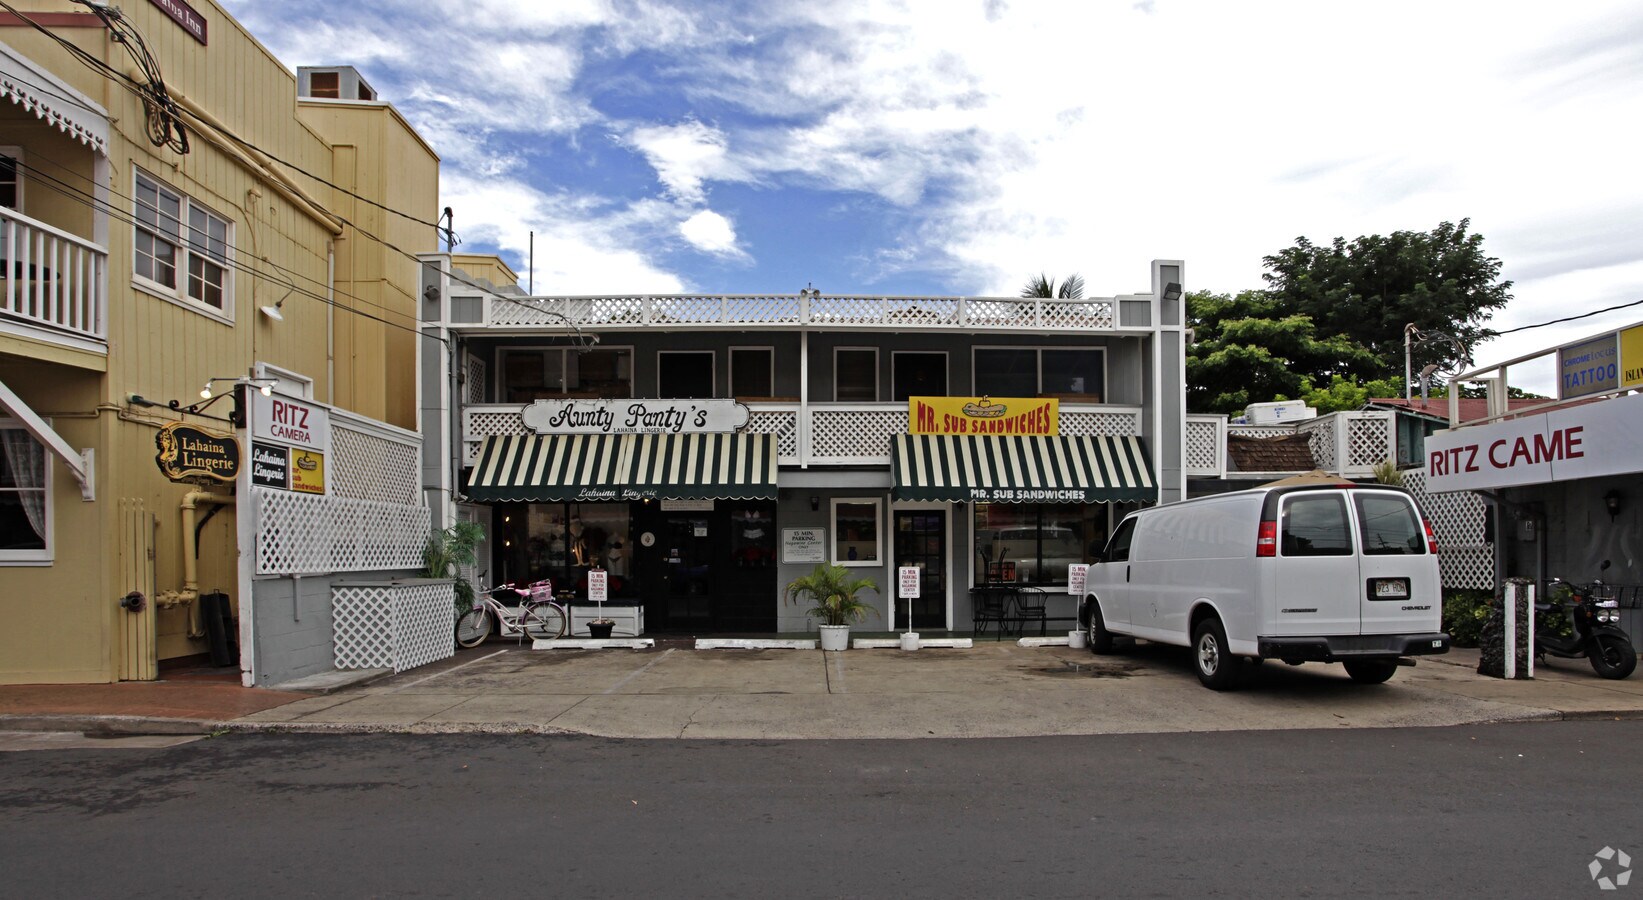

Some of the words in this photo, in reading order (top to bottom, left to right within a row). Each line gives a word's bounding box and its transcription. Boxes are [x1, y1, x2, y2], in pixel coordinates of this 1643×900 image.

[186, 10, 202, 35] Inn
[1564, 363, 1616, 388] TATTOO
[272, 400, 309, 429] RITZ
[549, 403, 615, 433] Aunty
[624, 403, 708, 433] Panty's
[917, 400, 939, 433] MR.
[943, 413, 967, 433] SUB
[971, 402, 1051, 434] SANDWICHES
[271, 424, 311, 443] CAMERA
[182, 437, 225, 454] Lahaina
[1430, 444, 1479, 477] RITZ
[1488, 425, 1584, 469] CAME
[183, 452, 234, 473] Lingerie
[252, 448, 286, 466] Lahaina
[253, 462, 285, 482] Lingerie
[578, 488, 616, 498] Lahaina
[970, 489, 990, 499] MR.
[993, 490, 1014, 499] SUB
[1016, 490, 1086, 500] SANDWICHES
[1376, 583, 1390, 593] 923
